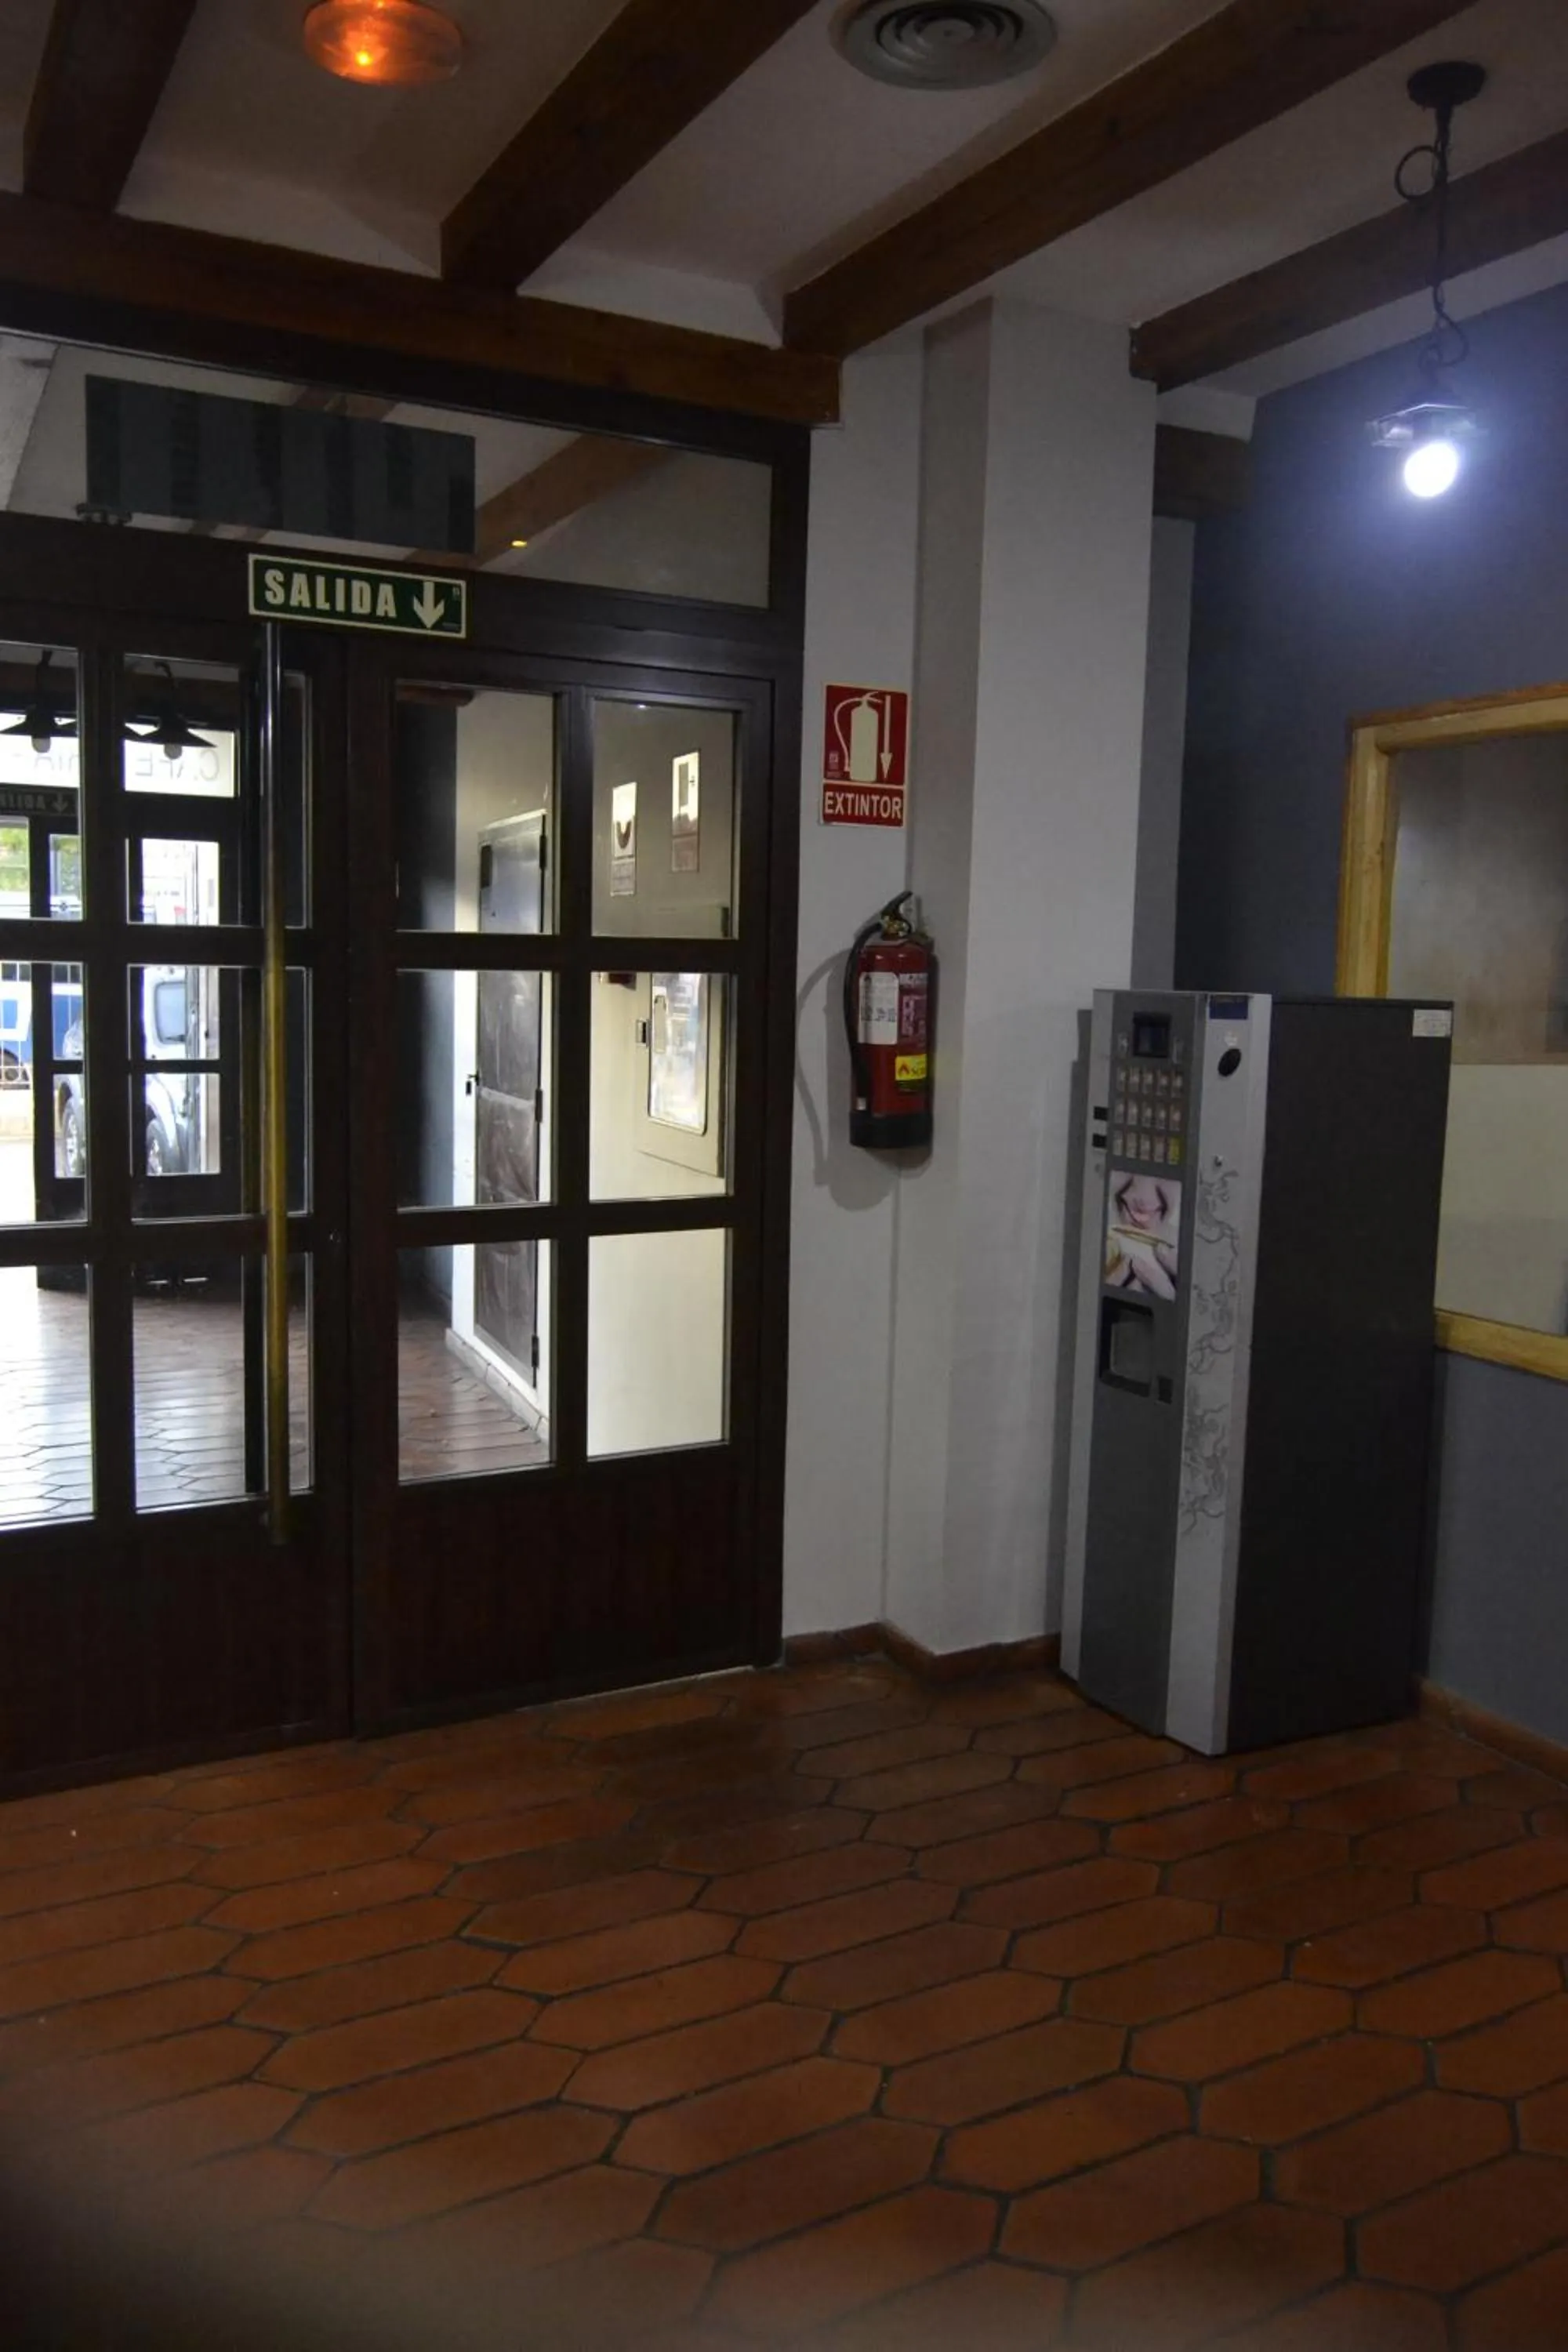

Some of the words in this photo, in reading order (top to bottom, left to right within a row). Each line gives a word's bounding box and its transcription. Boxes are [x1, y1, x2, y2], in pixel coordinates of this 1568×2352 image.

[263, 568, 397, 618] SALIDA
[0, 792, 46, 811] ALIDA
[824, 790, 902, 820] EXTINTOR
